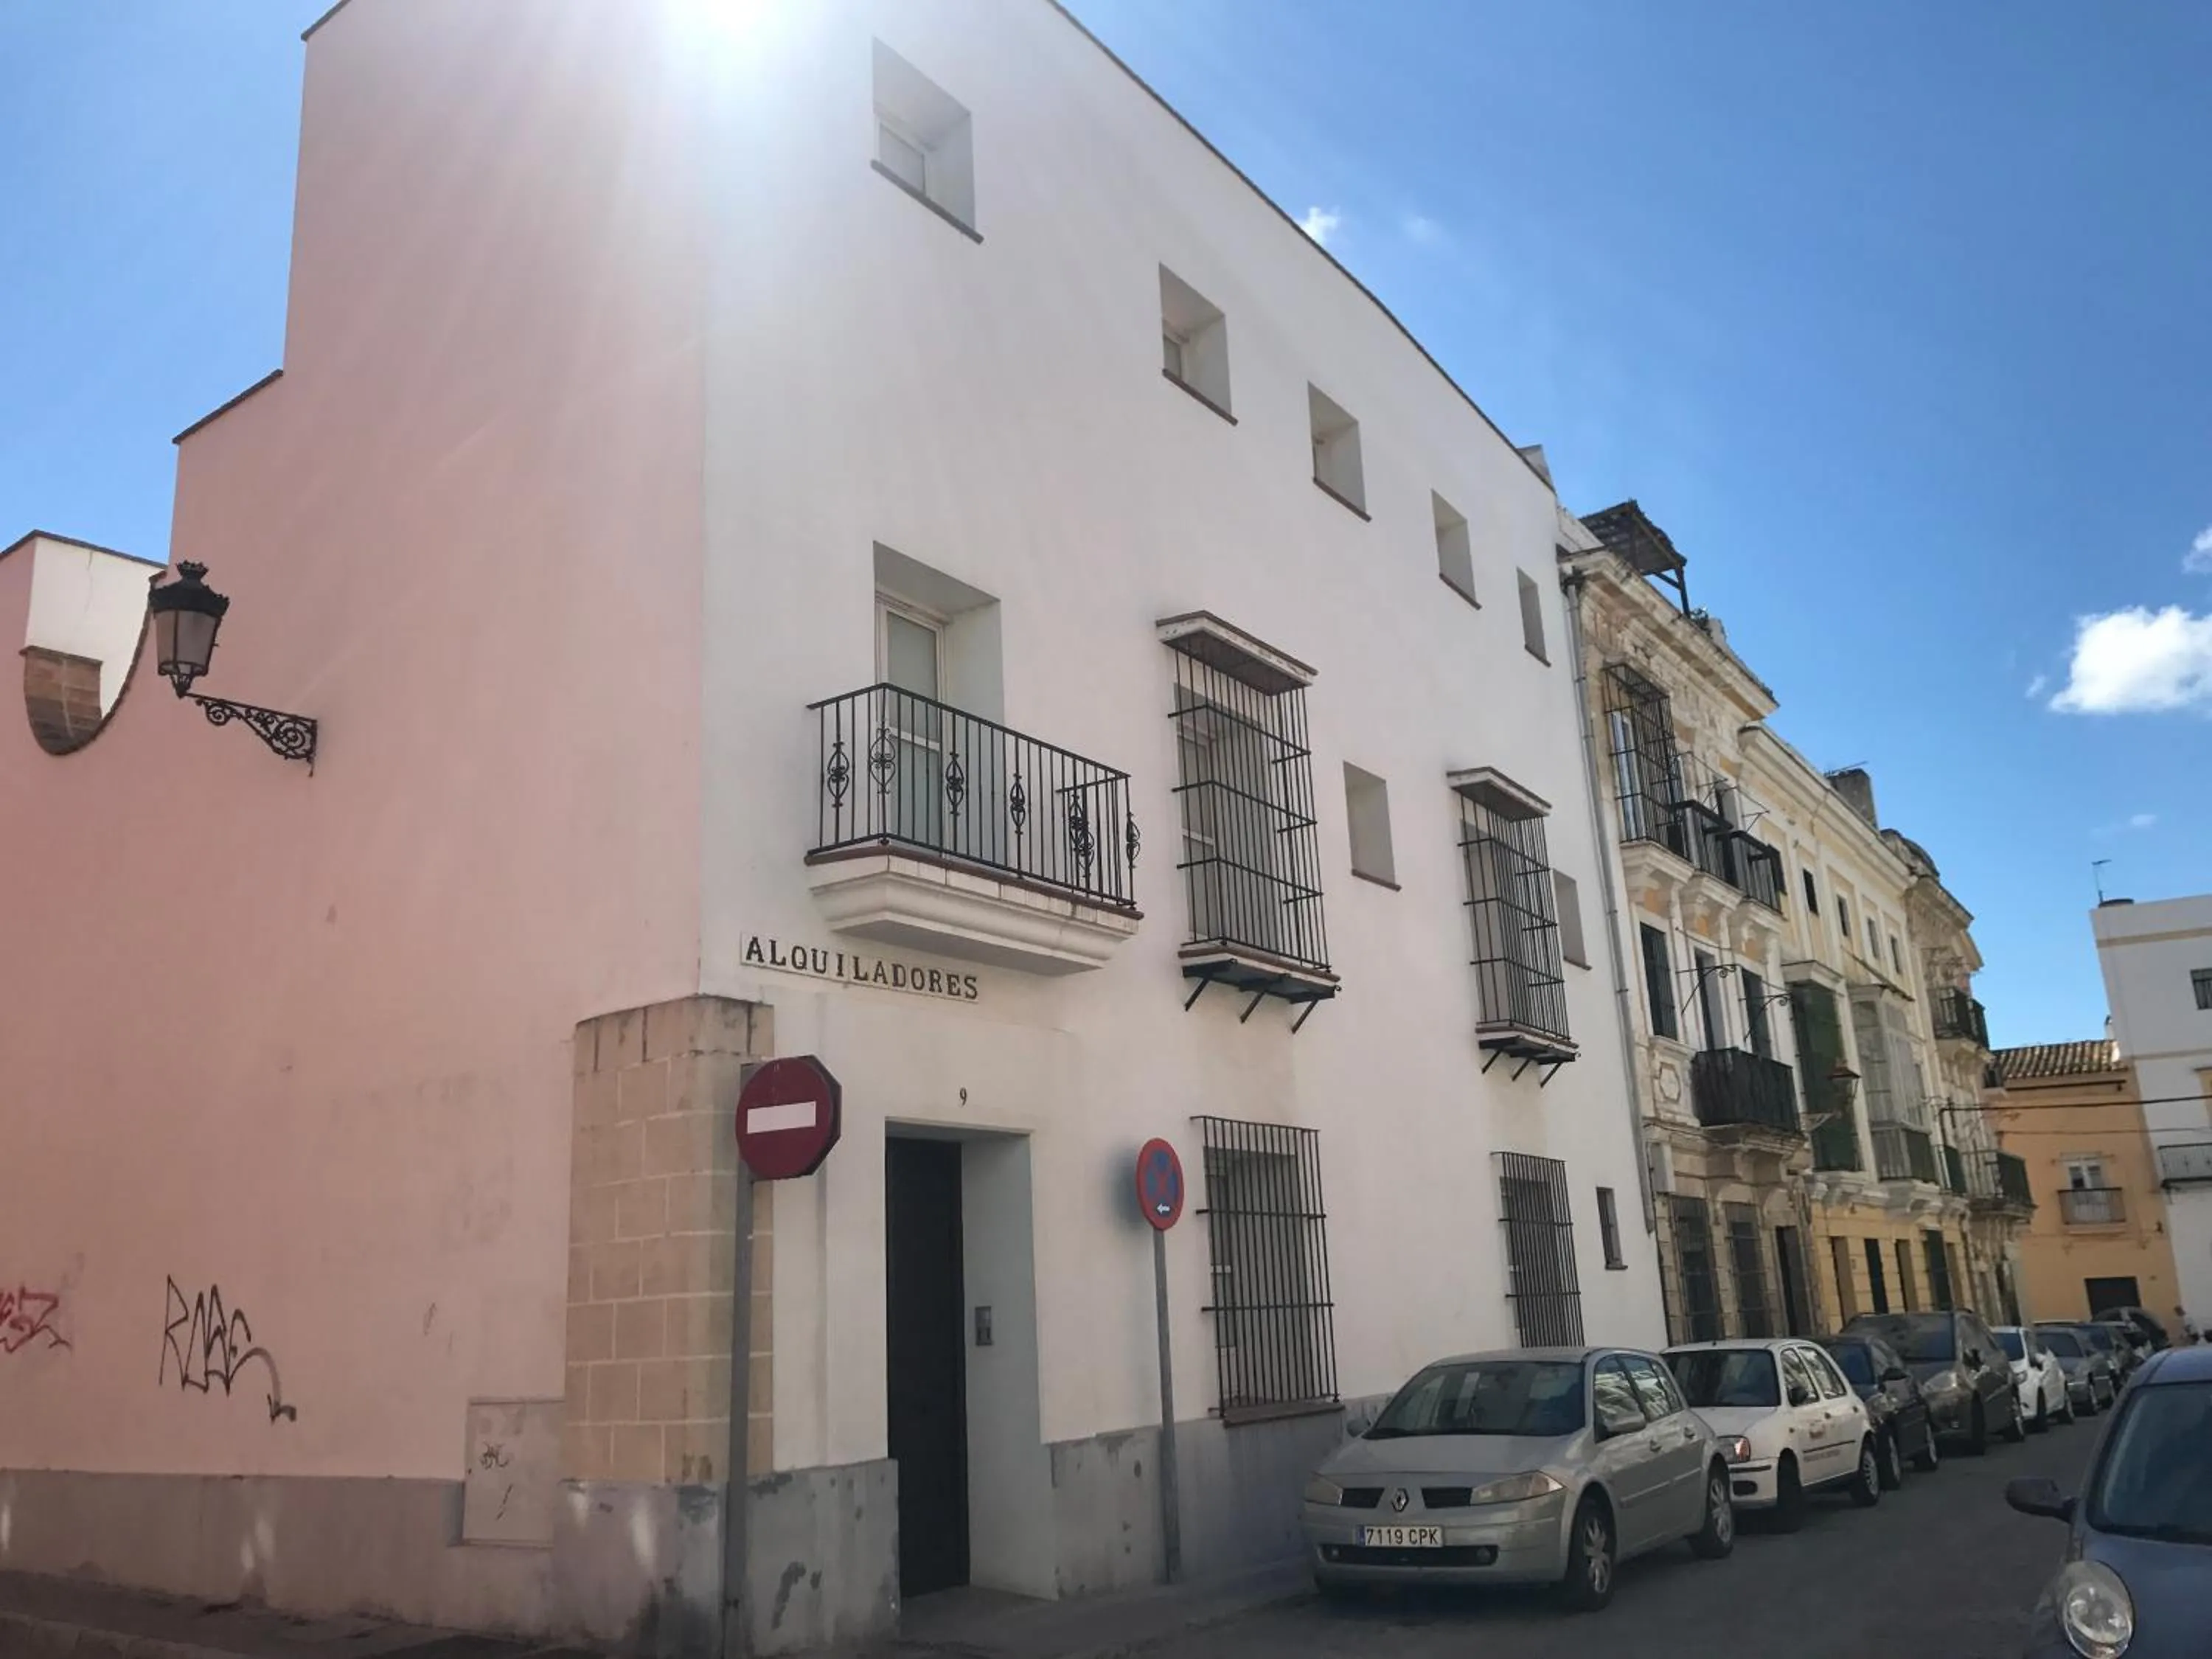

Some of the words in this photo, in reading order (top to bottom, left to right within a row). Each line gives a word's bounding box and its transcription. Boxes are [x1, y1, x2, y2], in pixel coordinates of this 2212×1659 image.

[745, 936, 978, 1000] ALQUILADORES
[959, 1087, 967, 1107] 9
[1366, 1528, 1403, 1545] 7119
[1409, 1528, 1439, 1545] CPK
